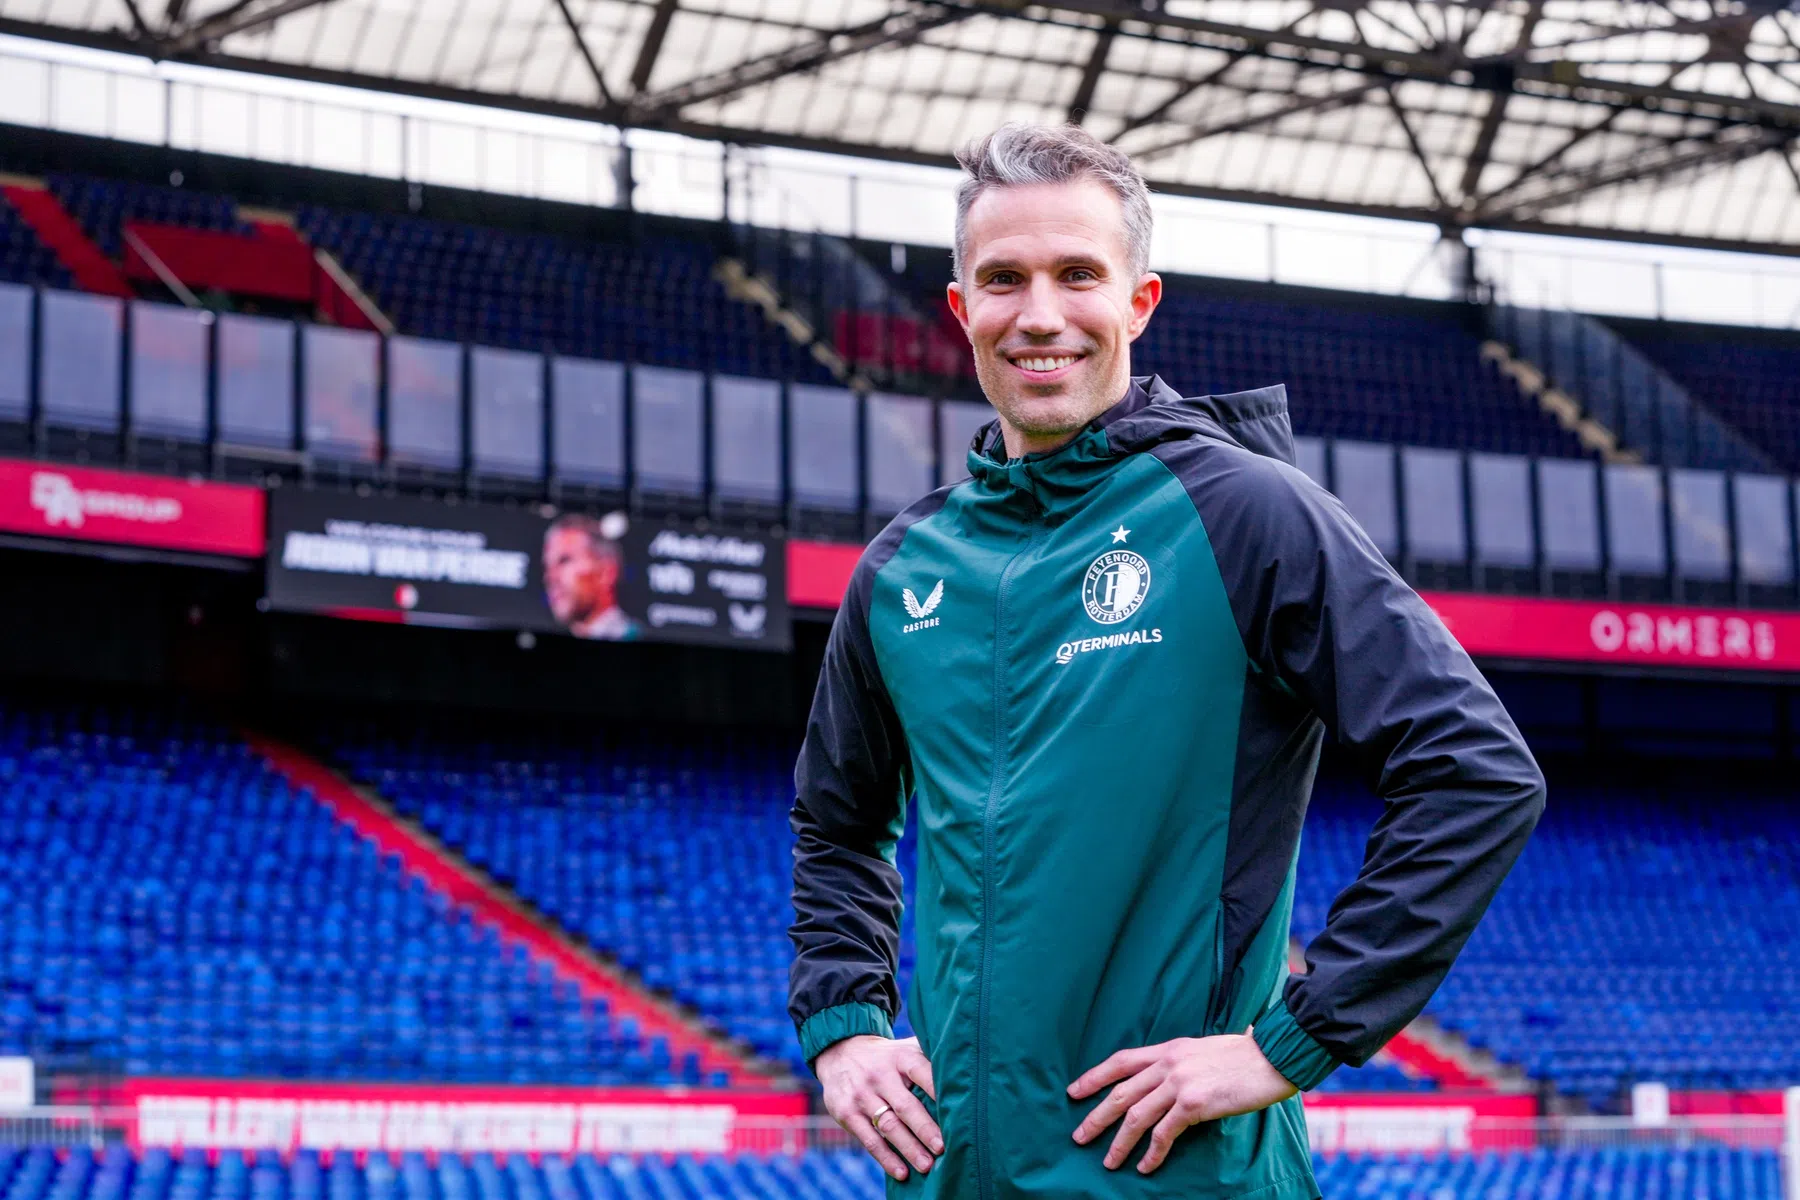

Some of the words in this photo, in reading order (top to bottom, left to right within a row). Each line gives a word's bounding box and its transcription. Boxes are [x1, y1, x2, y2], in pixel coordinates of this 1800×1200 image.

[1088, 553, 1147, 581] FEYENOORD
[1087, 593, 1143, 622] ROTTERDAM
[903, 617, 940, 633] CASTORE
